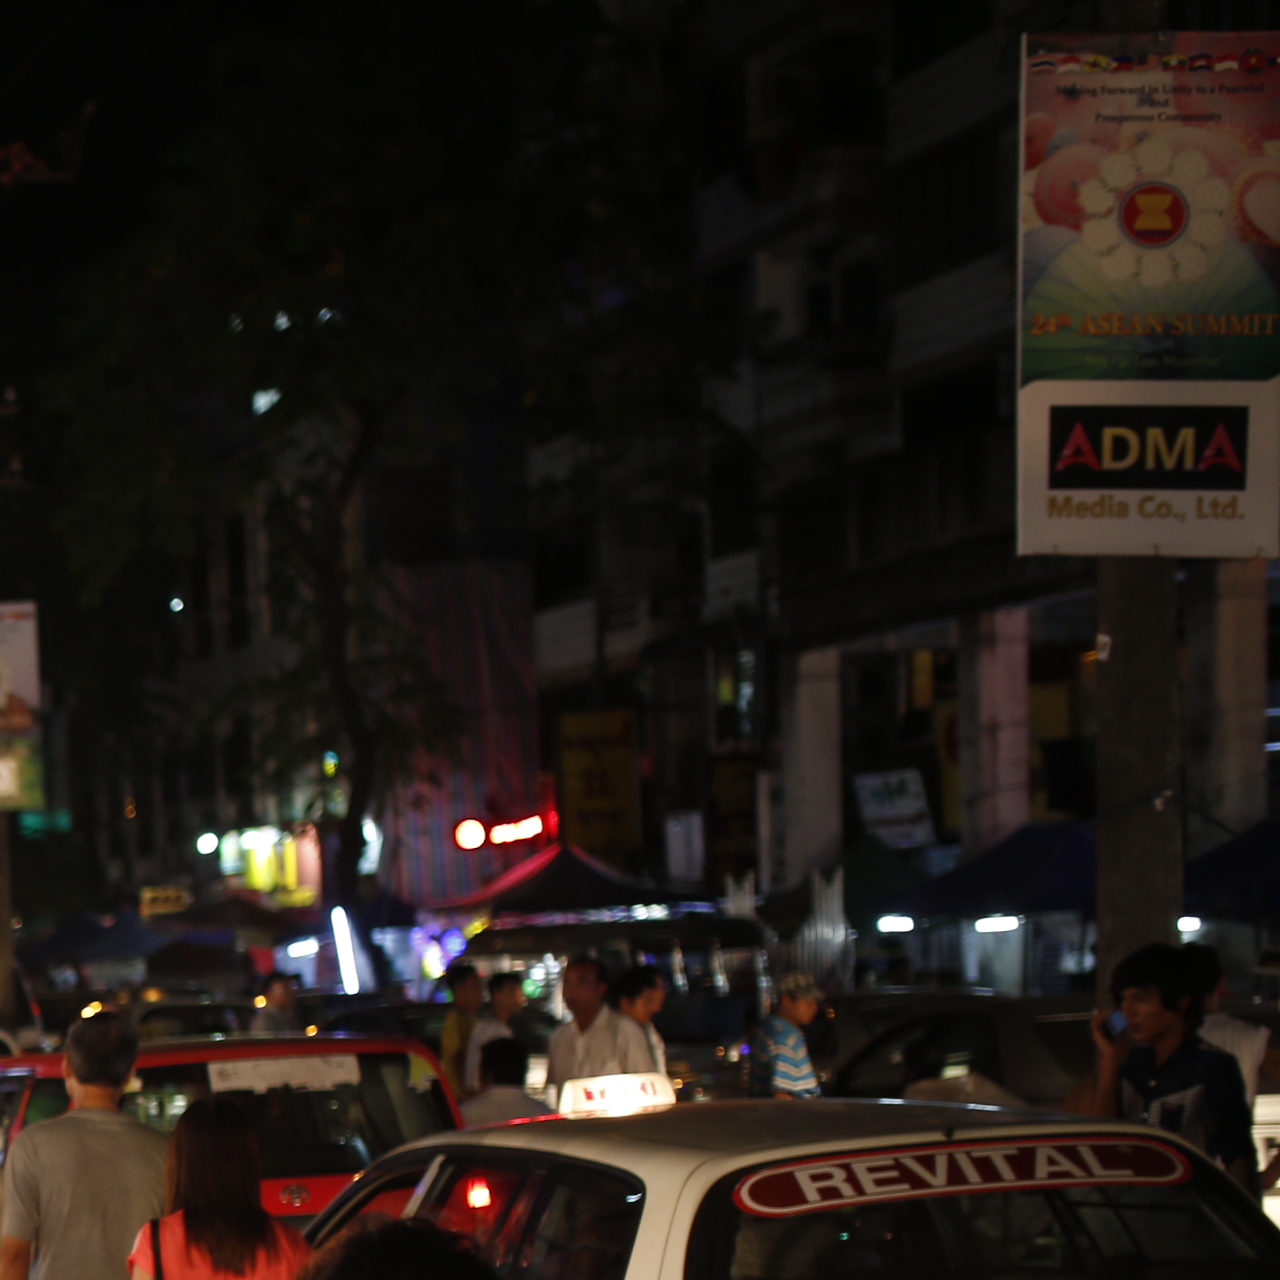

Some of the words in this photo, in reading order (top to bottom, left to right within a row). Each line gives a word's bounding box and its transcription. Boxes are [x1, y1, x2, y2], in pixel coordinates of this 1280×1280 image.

[1056, 84, 1097, 97] Ming
[1100, 83, 1146, 95] Forward
[1163, 83, 1193, 97] Unity
[1218, 82, 1266, 94] Peaceful
[1095, 112, 1155, 124] Prosperous
[1157, 112, 1223, 124] Community
[1078, 313, 1166, 336] ASEAN
[1170, 313, 1280, 336] SUMMIT
[1053, 419, 1245, 472] ADMA
[1047, 494, 1130, 519] Media
[1136, 495, 1187, 522] Co.,
[1196, 494, 1245, 519] Ltd.
[793, 1144, 1134, 1203] REVITAL
